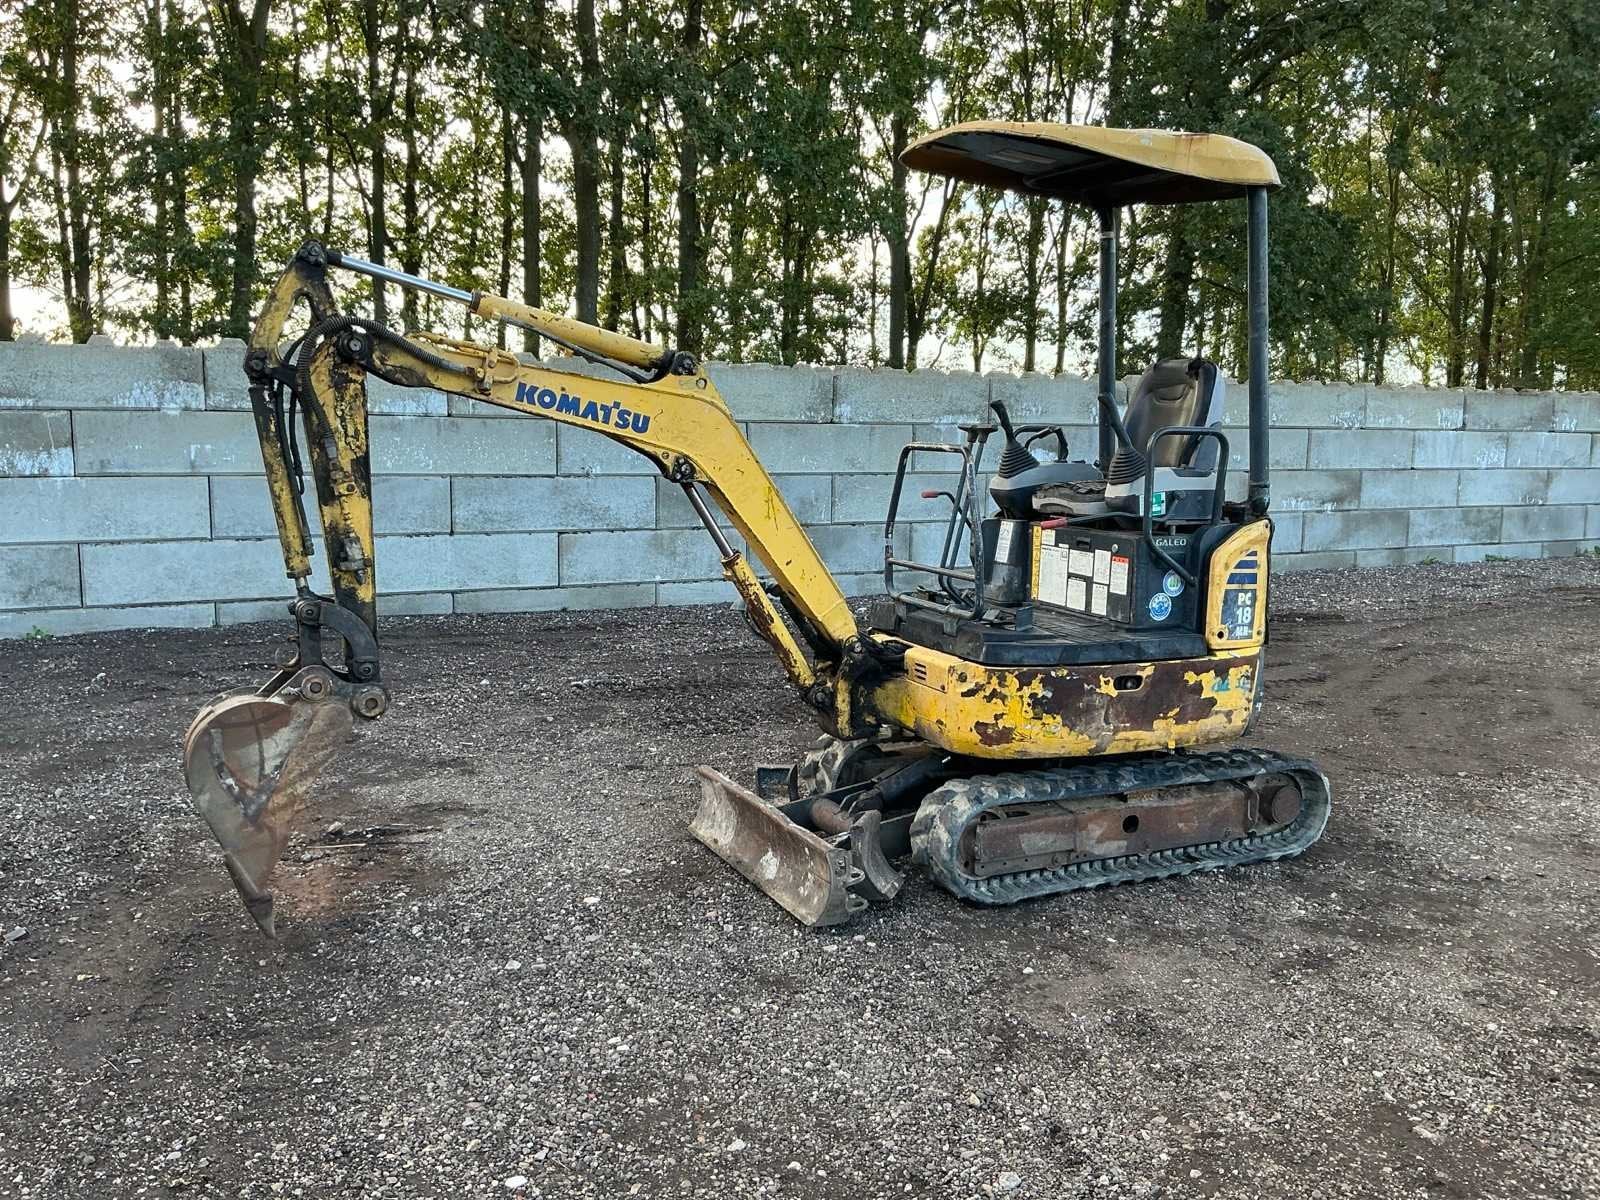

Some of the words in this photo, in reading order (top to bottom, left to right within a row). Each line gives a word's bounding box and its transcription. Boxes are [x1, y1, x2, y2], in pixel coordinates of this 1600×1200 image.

[515, 382, 650, 433] KOMATSU
[1156, 538, 1187, 546] GALEO
[1238, 592, 1252, 606] PC
[1237, 606, 1252, 624] 18
